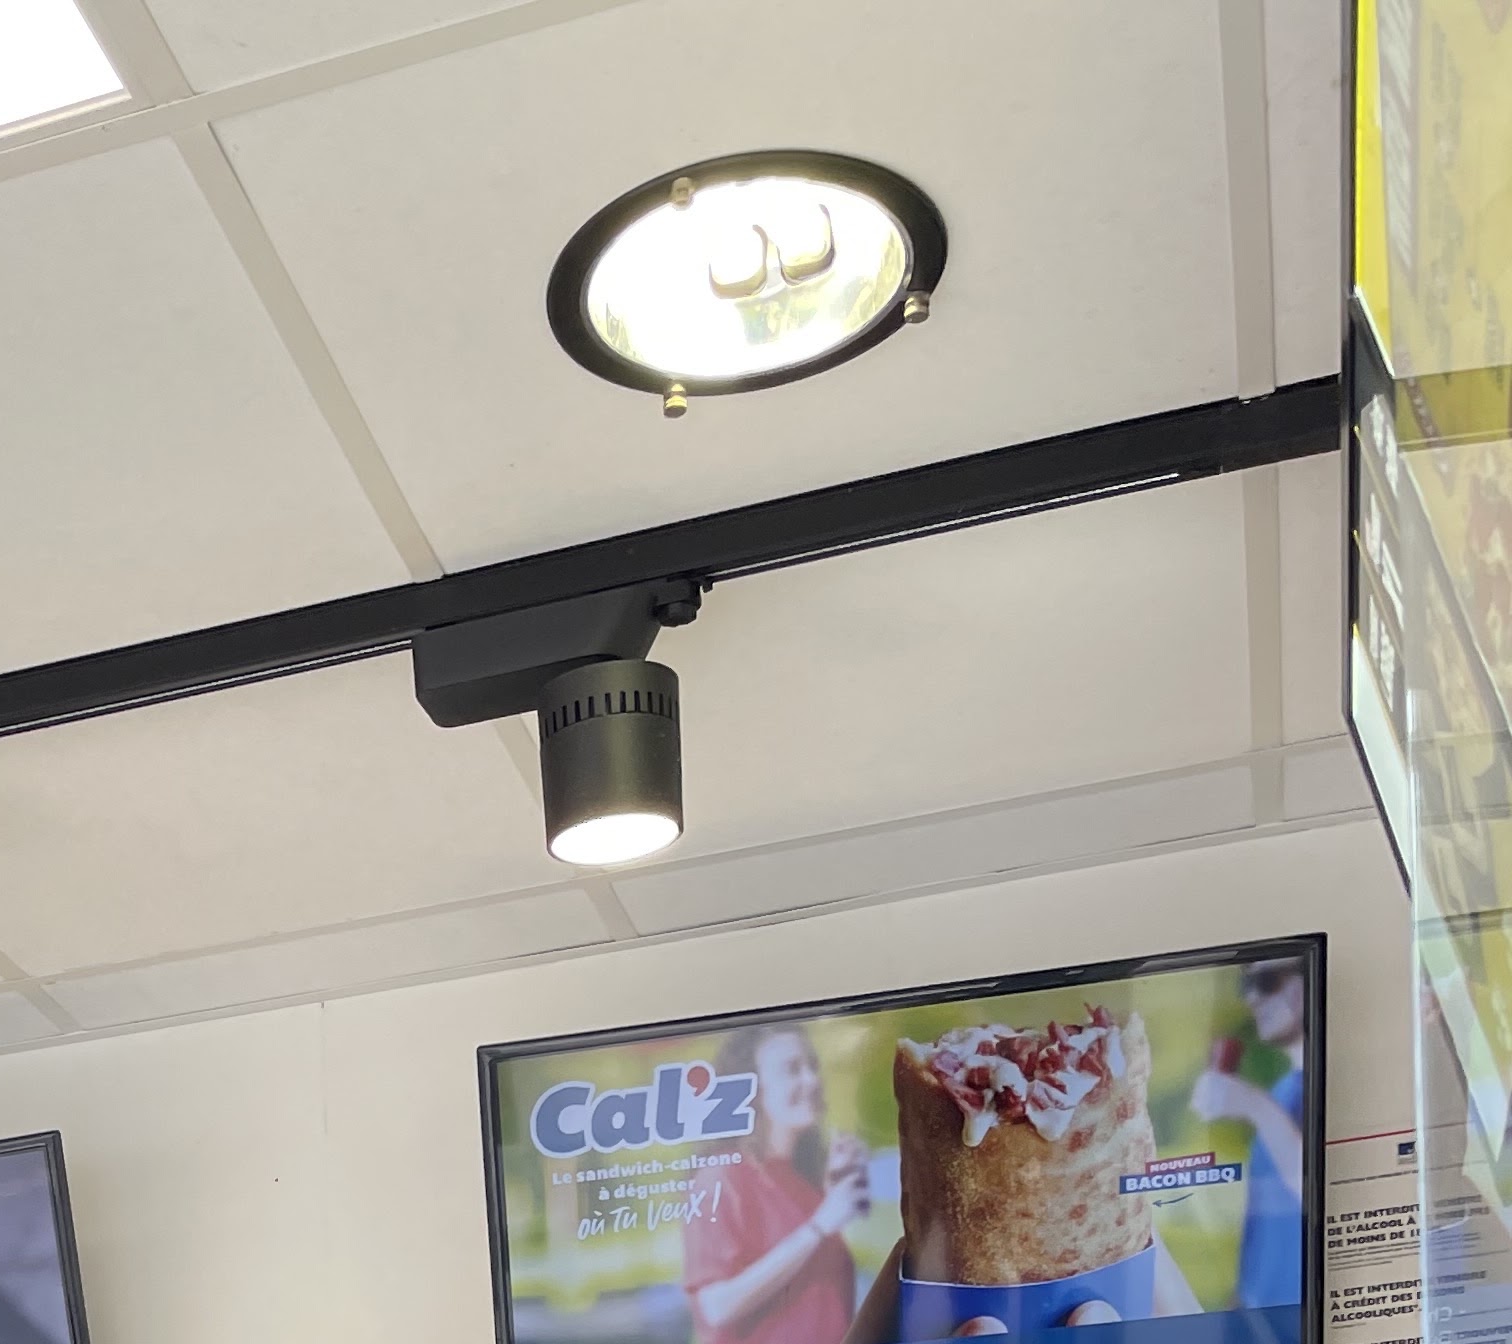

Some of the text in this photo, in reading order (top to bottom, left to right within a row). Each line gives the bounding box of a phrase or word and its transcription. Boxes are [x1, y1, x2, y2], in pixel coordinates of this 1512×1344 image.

[534, 1064, 755, 1154] Cal'z
[552, 1152, 743, 1185] Le sandwich-calzone
[1150, 1155, 1211, 1172] NOUVEAU
[1125, 1167, 1236, 1191] BACON BBQ
[614, 1179, 696, 1199] déguster
[710, 1181, 721, 1222] !
[1341, 1212, 1360, 1221] EST
[1327, 1227, 1342, 1236] DE
[1346, 1219, 1404, 1233] L'ALCOOL
[1328, 1231, 1405, 1249] DE MOINS DE
[1344, 1287, 1364, 1297] EST
[1344, 1295, 1387, 1309] CRÉDIT
[1391, 1293, 1413, 1303] DES
